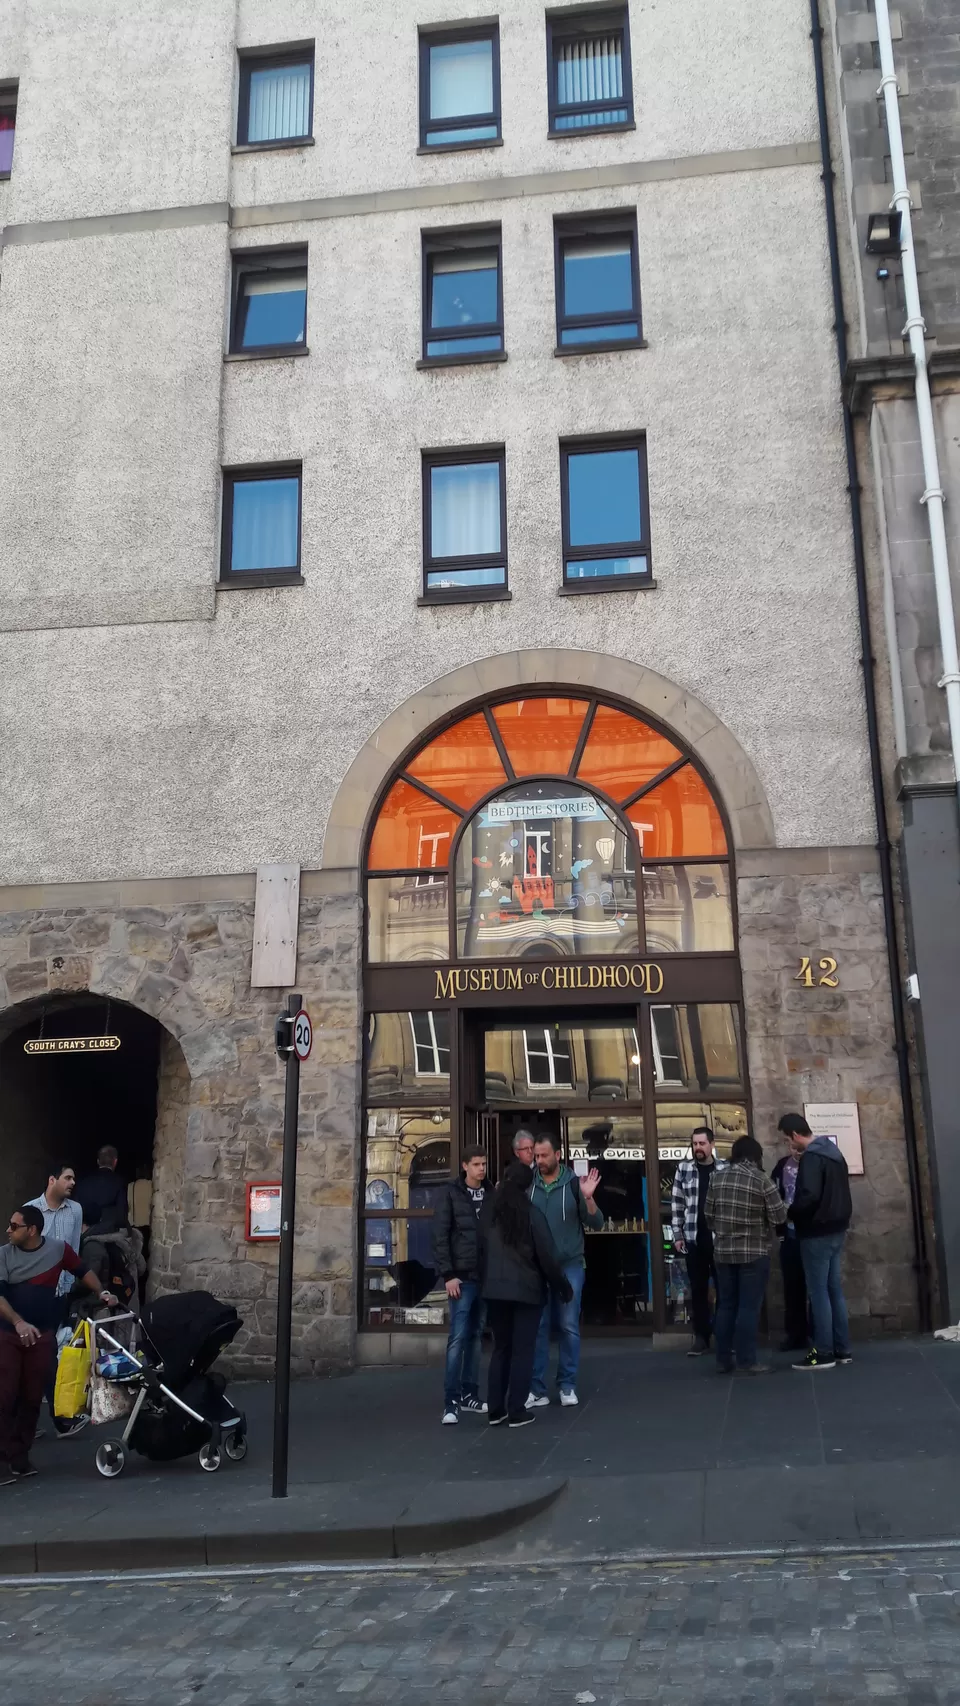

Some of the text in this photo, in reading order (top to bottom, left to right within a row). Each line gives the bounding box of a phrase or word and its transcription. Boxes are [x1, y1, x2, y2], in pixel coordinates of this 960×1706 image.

[490, 801, 595, 818] BEDTIME STORIES
[434, 963, 664, 999] MUSEUM OF CHILDHOOD
[793, 956, 839, 987] 42
[29, 1042, 56, 1051] SOUTH
[89, 1039, 115, 1048] CLOSE
[296, 1023, 310, 1047] 20
